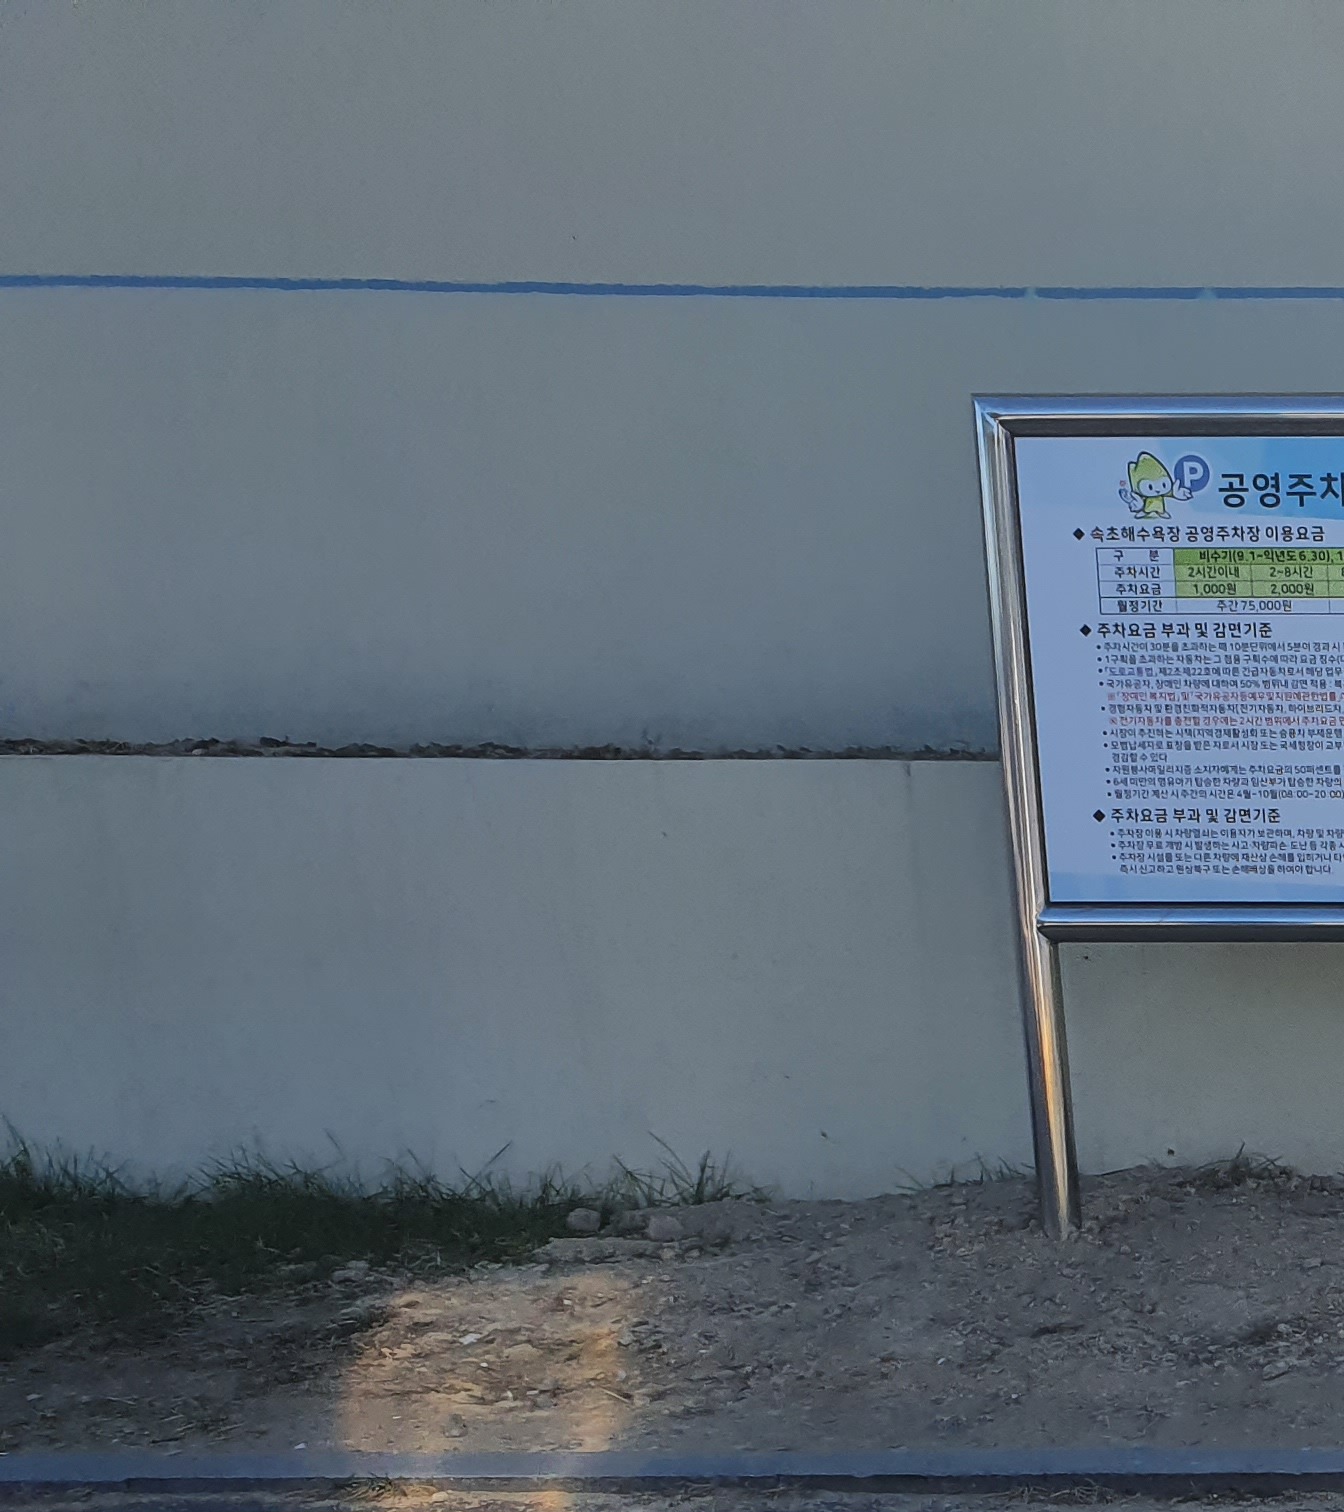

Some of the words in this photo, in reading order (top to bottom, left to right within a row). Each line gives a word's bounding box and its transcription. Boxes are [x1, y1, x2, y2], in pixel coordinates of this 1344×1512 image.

[1183, 461, 1204, 488] P
[1090, 526, 1180, 543] 속초해수욕장
[1185, 526, 1260, 543] 공영주차장
[1265, 526, 1325, 543] 이용요금
[1115, 566, 1160, 578] 주차시간
[1188, 566, 1240, 578] 2시간이내
[1116, 583, 1161, 595] 주차요금
[1193, 583, 1237, 595] 1,000원
[1270, 583, 1314, 596] 2,000원
[1117, 600, 1162, 612] 월정기간
[1242, 600, 1292, 612] 75,000원
[1098, 622, 1156, 638] 주차요금
[1162, 622, 1190, 638] 부과
[1195, 622, 1208, 638] 및
[1213, 622, 1272, 638] 감면기준
[1111, 808, 1168, 823] 주차요금
[1173, 808, 1200, 823] 부과
[1206, 808, 1219, 823] 및
[1224, 808, 1280, 823] 감면기준
